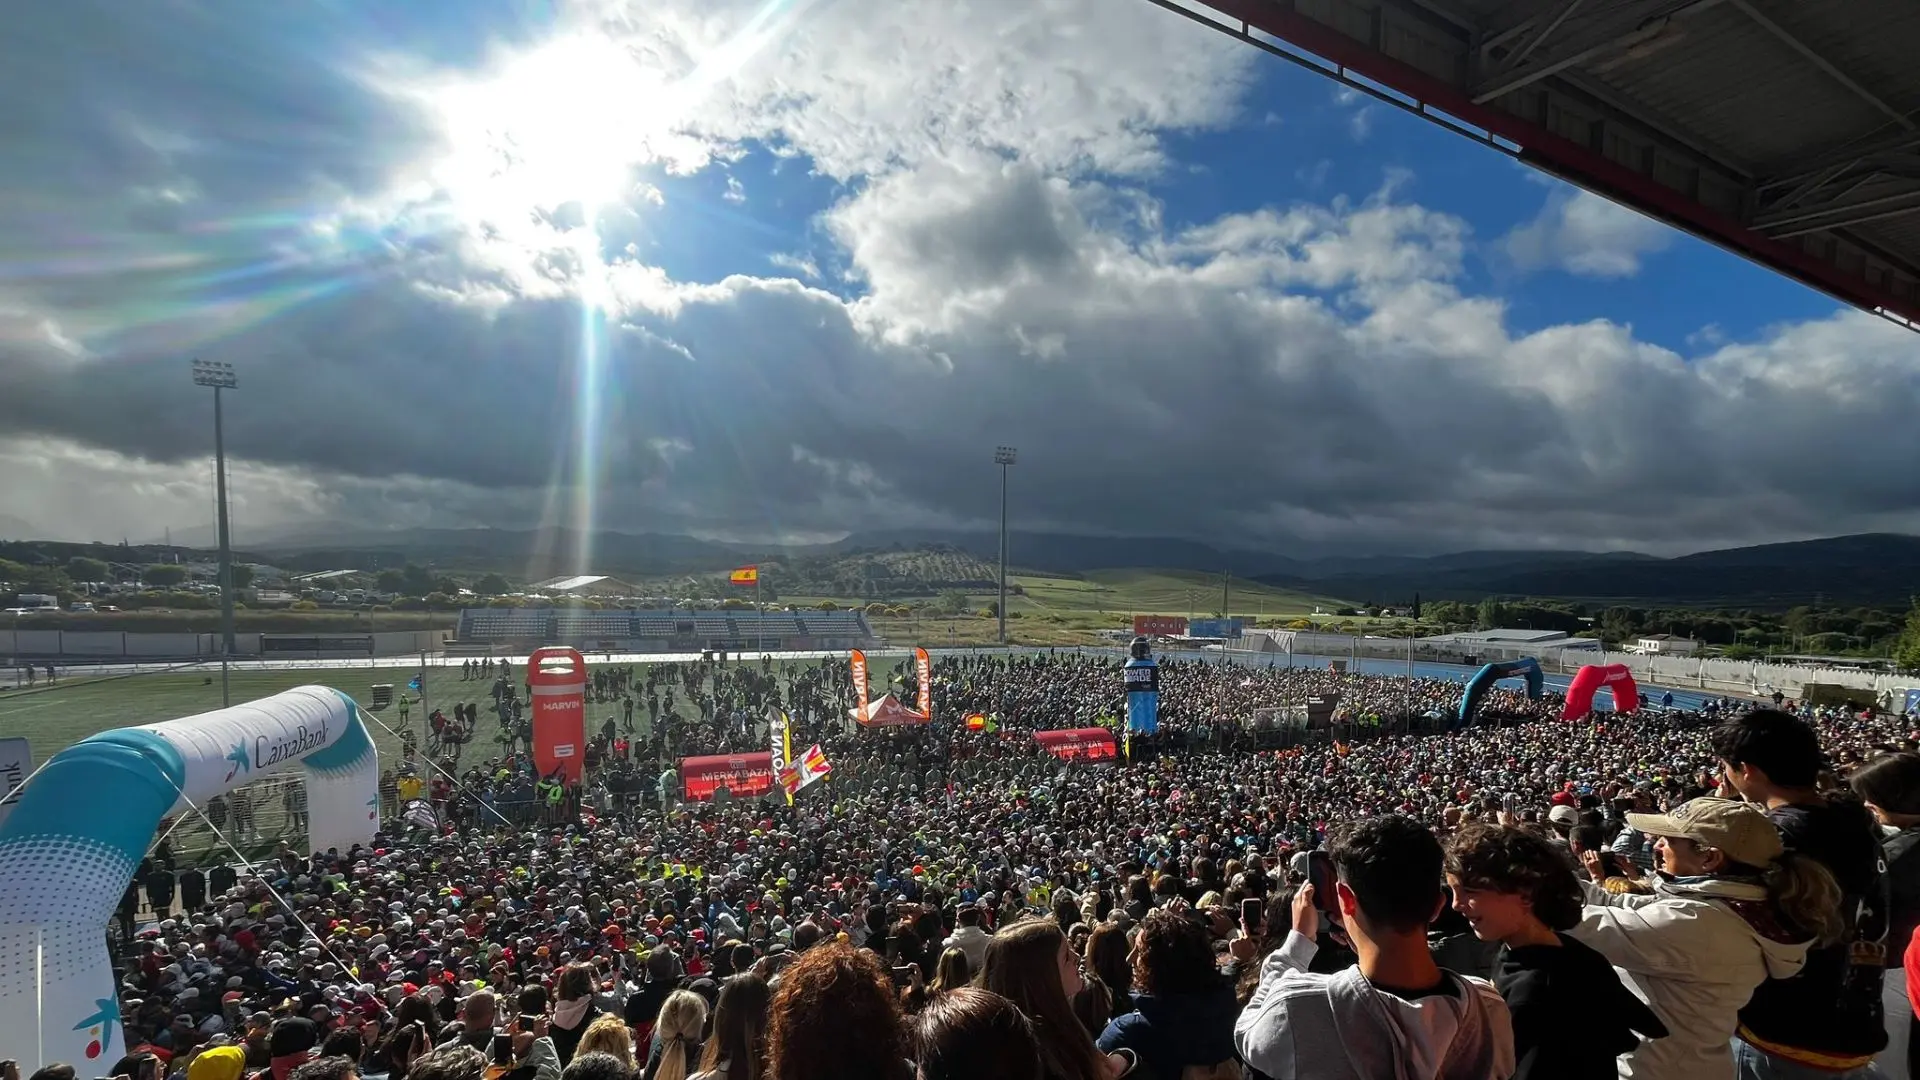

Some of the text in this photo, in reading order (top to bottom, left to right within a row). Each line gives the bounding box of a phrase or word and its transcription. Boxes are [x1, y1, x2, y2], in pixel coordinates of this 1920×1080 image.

[543, 701, 579, 710] MARVIN
[256, 719, 328, 769] CaixaBank
[701, 769, 773, 782] MERKABAZA
